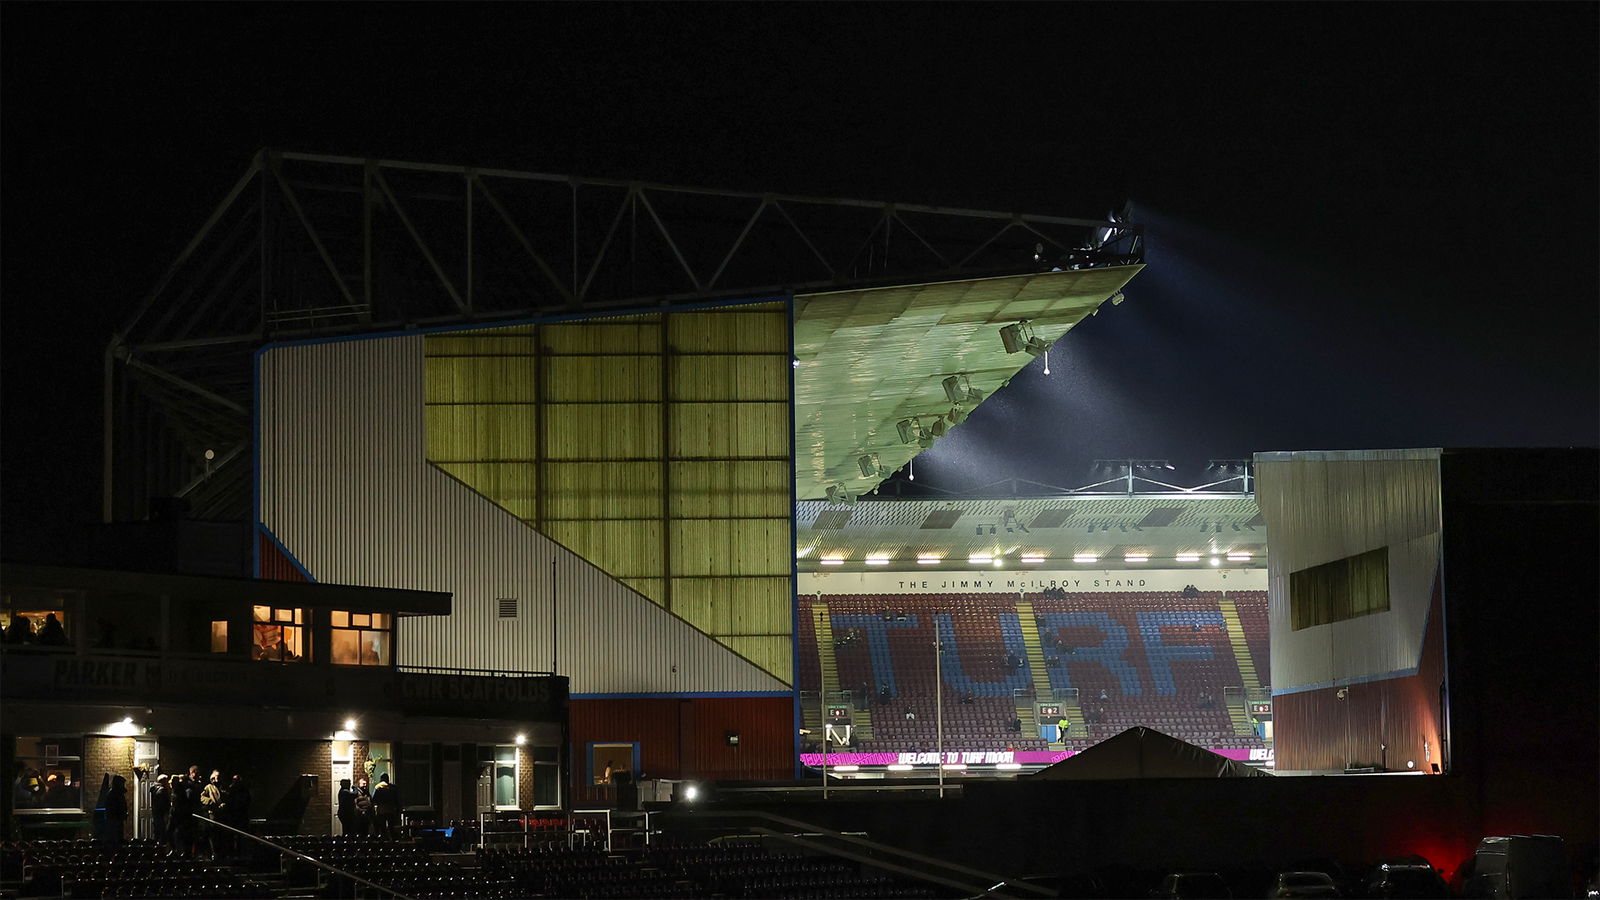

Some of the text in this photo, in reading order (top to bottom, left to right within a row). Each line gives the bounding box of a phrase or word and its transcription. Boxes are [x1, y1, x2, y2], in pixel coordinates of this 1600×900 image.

[899, 579, 1146, 589] THE JIMMY McILROY STAND
[831, 611, 1226, 699] TURF
[54, 659, 137, 687] PARKER
[449, 677, 550, 702] SCAFFOLDS
[946, 752, 959, 763] TO
[961, 751, 986, 763] TURF
[985, 751, 1014, 763] MOOR
